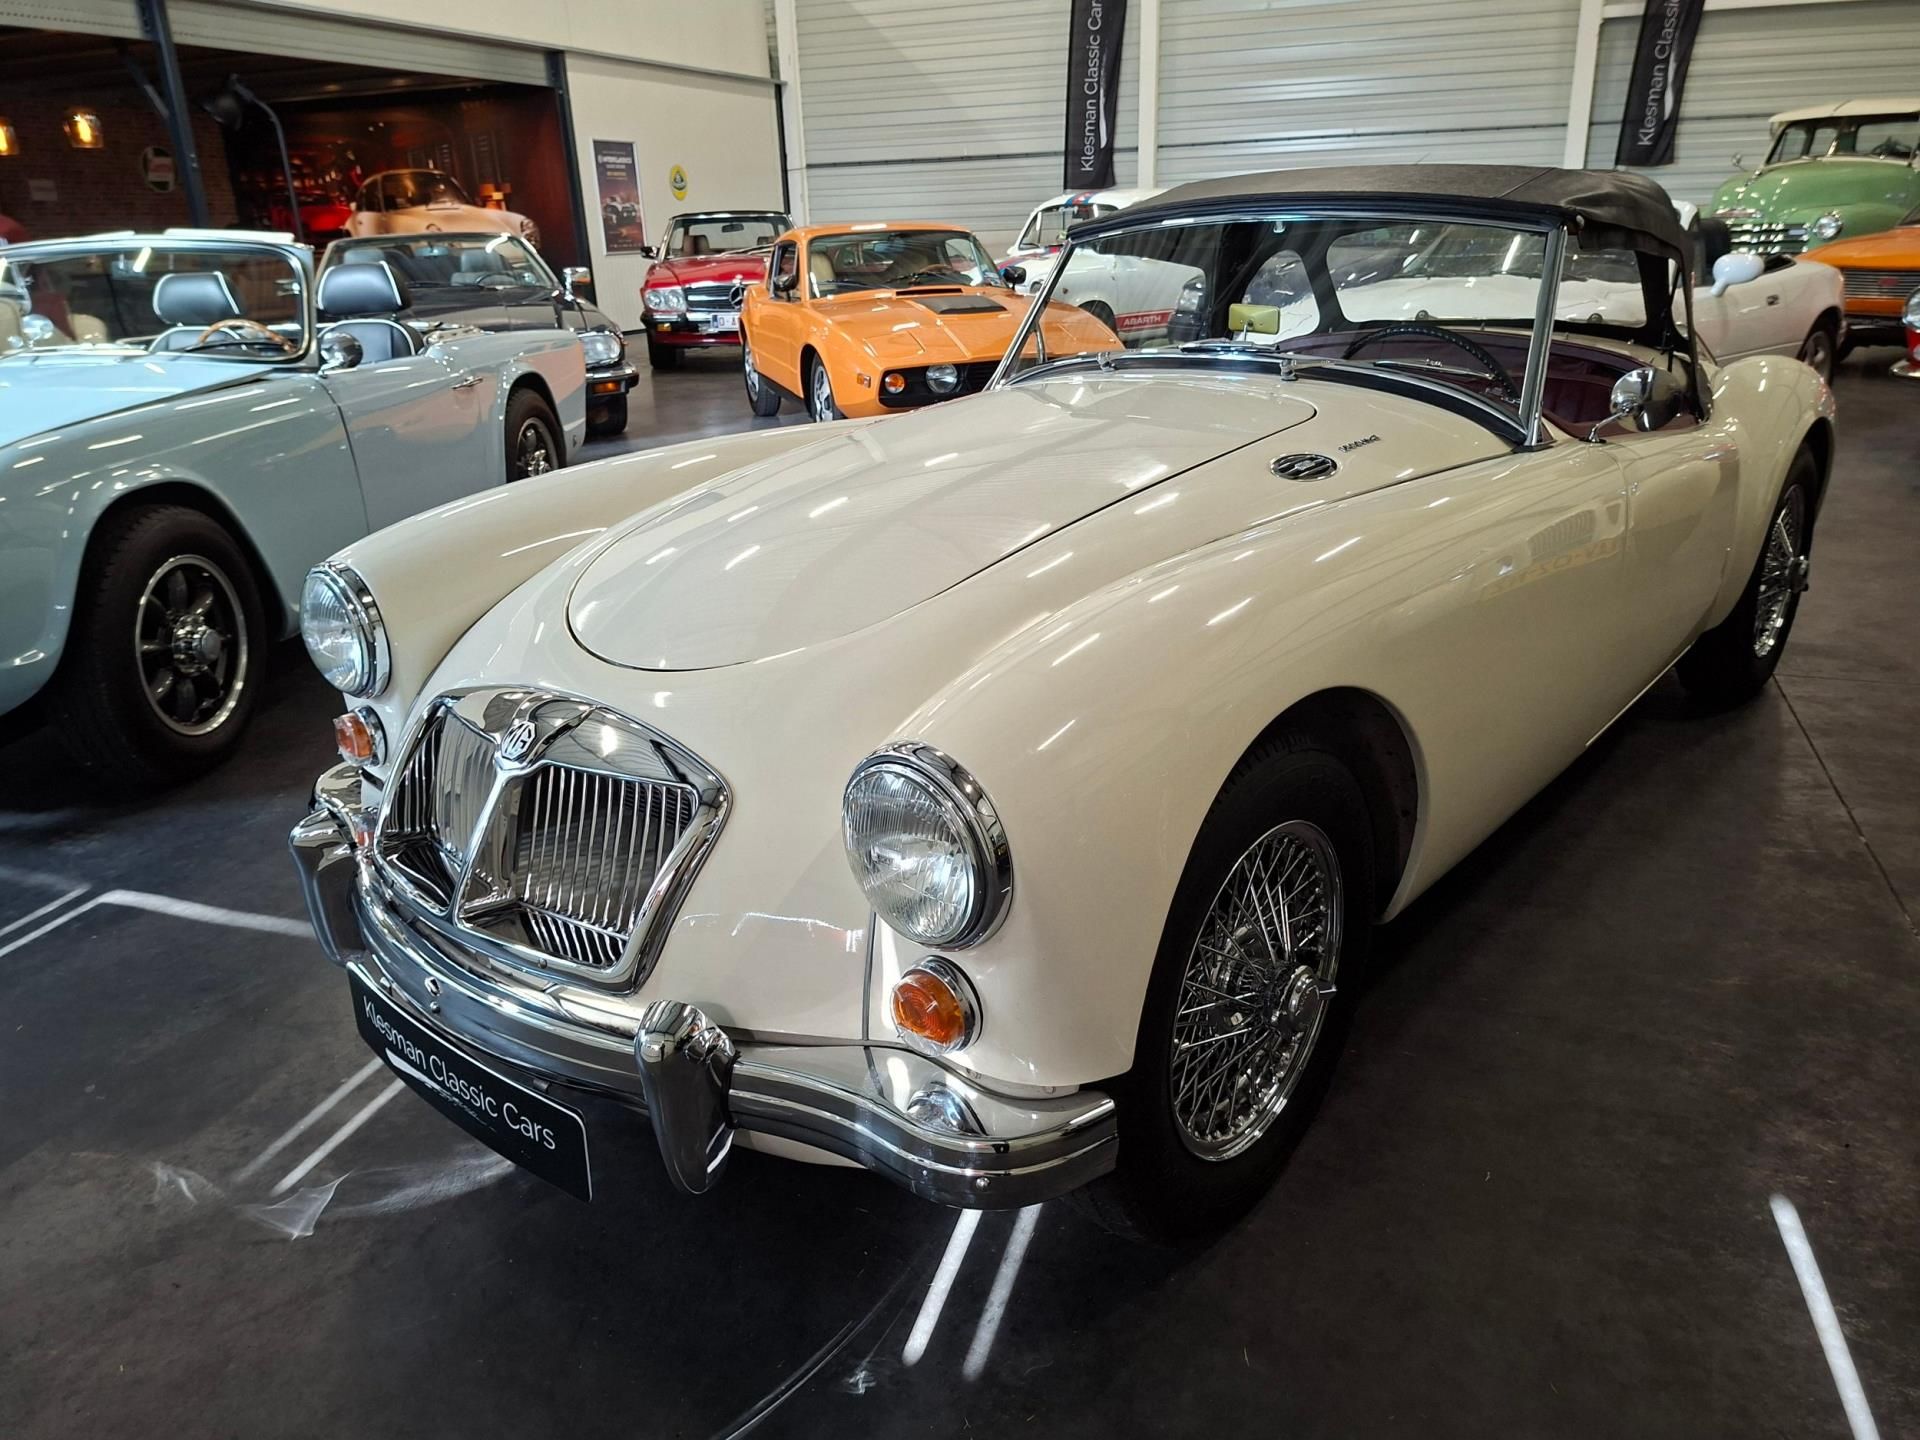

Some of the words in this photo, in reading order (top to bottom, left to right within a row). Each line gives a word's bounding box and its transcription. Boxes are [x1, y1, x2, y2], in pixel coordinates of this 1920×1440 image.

[1084, 34, 1101, 95] Classic
[1080, 99, 1097, 172] Klesman
[1636, 64, 1666, 146] Klesman
[1123, 315, 1162, 327] ABARTH
[504, 723, 533, 755] MG
[363, 995, 427, 1070] Klesman
[429, 1054, 498, 1118] Classic
[503, 1102, 556, 1150] Cars
